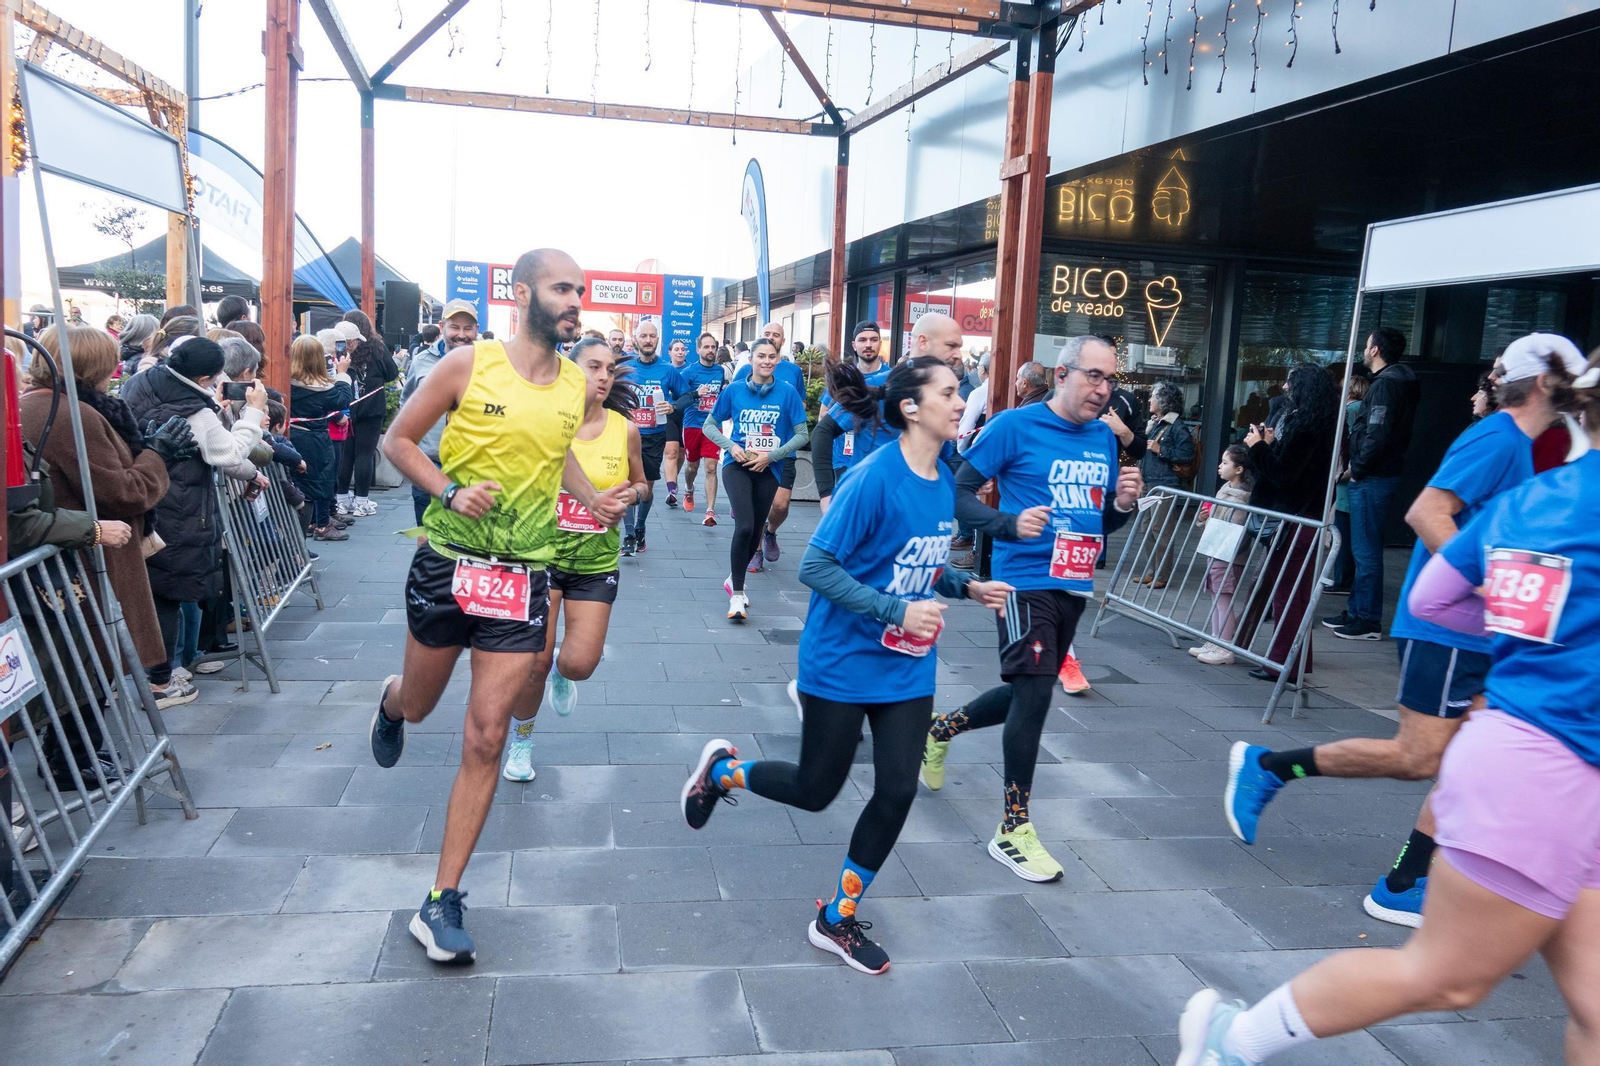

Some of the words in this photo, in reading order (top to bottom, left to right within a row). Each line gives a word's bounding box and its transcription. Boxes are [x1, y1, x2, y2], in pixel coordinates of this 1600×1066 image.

[594, 284, 633, 293] CONCELLO
[1053, 265, 1128, 299] BICO
[1051, 297, 1072, 314] de
[1076, 301, 1124, 317] xeado
[484, 403, 506, 416] DK
[636, 412, 652, 421] 535
[739, 408, 780, 425] CORRER
[755, 437, 774, 448] 305
[1048, 459, 1109, 488] CORRER
[560, 519, 595, 530] Alcampo
[1071, 546, 1097, 565] 539
[477, 575, 516, 600] 524
[466, 601, 512, 617] Alcampo
